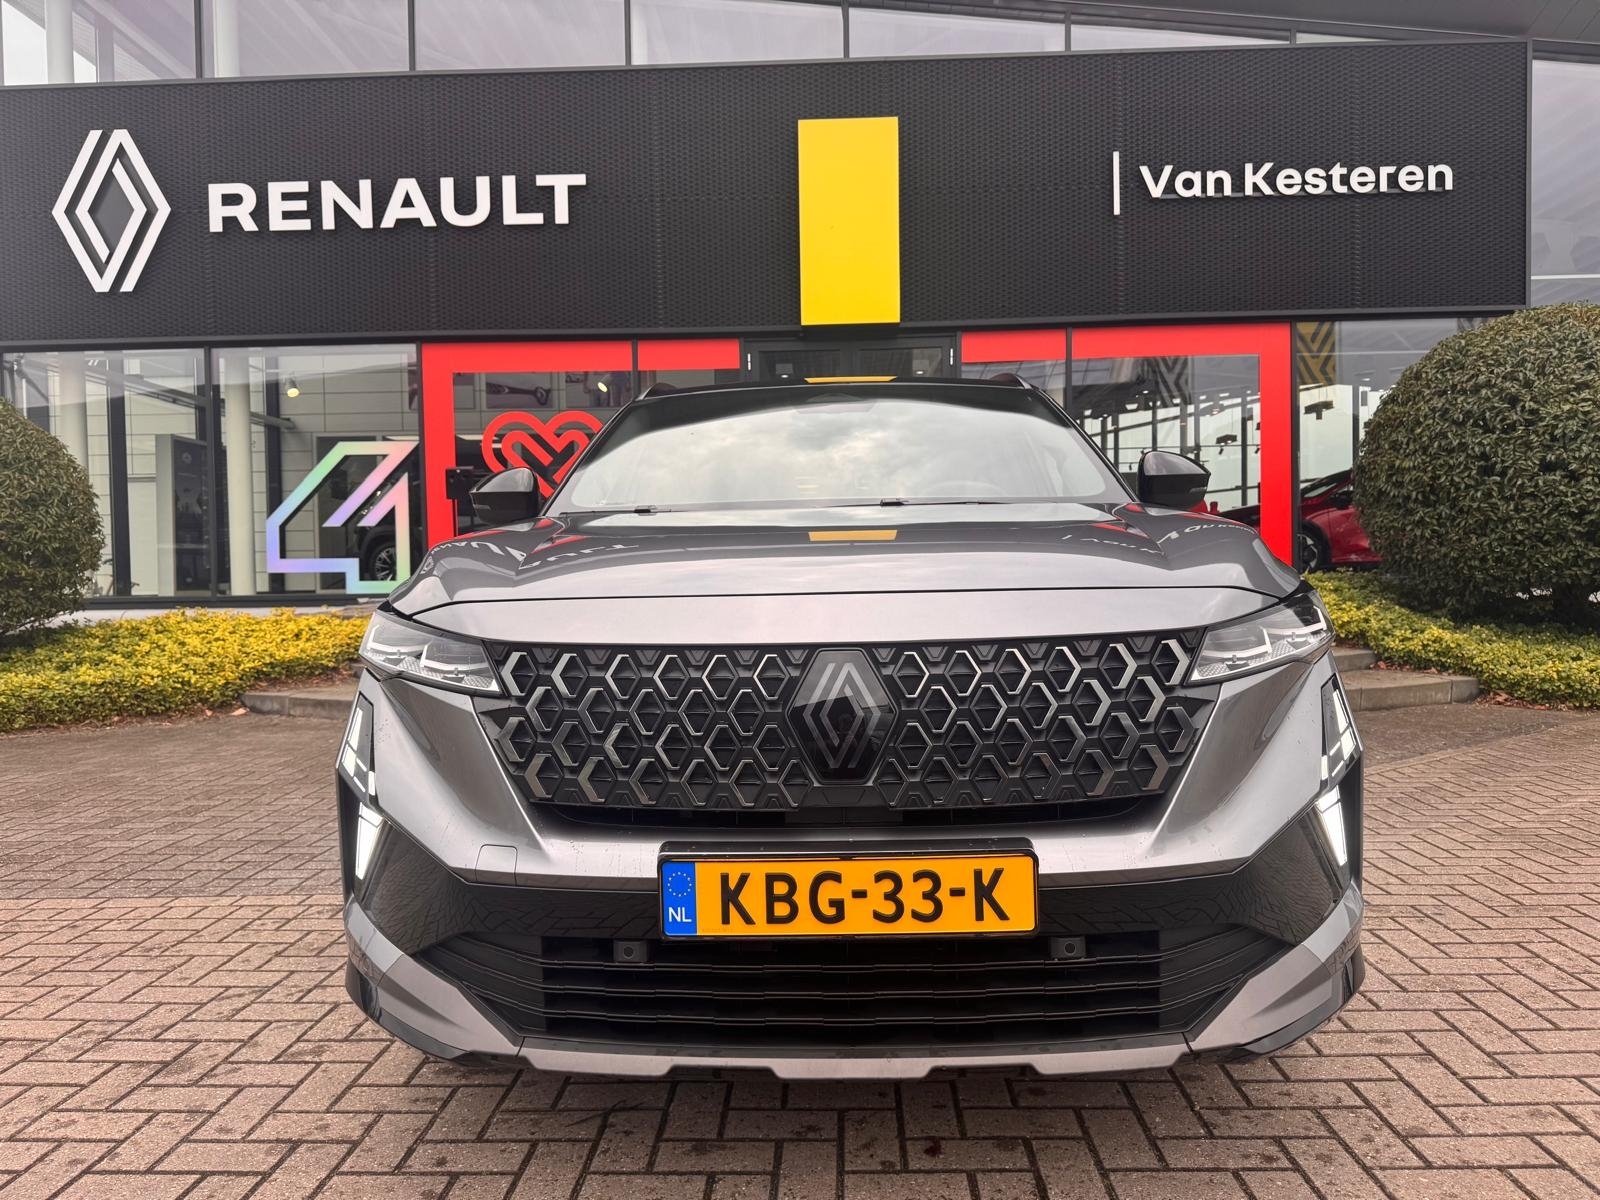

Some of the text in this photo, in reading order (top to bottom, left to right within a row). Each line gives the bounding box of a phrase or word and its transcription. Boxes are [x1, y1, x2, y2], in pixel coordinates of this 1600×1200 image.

[207, 173, 587, 233] RENAULT
[1138, 161, 1454, 199] Van Kesteren
[668, 906, 692, 923] NL
[720, 867, 1010, 926] KBG-33-K
